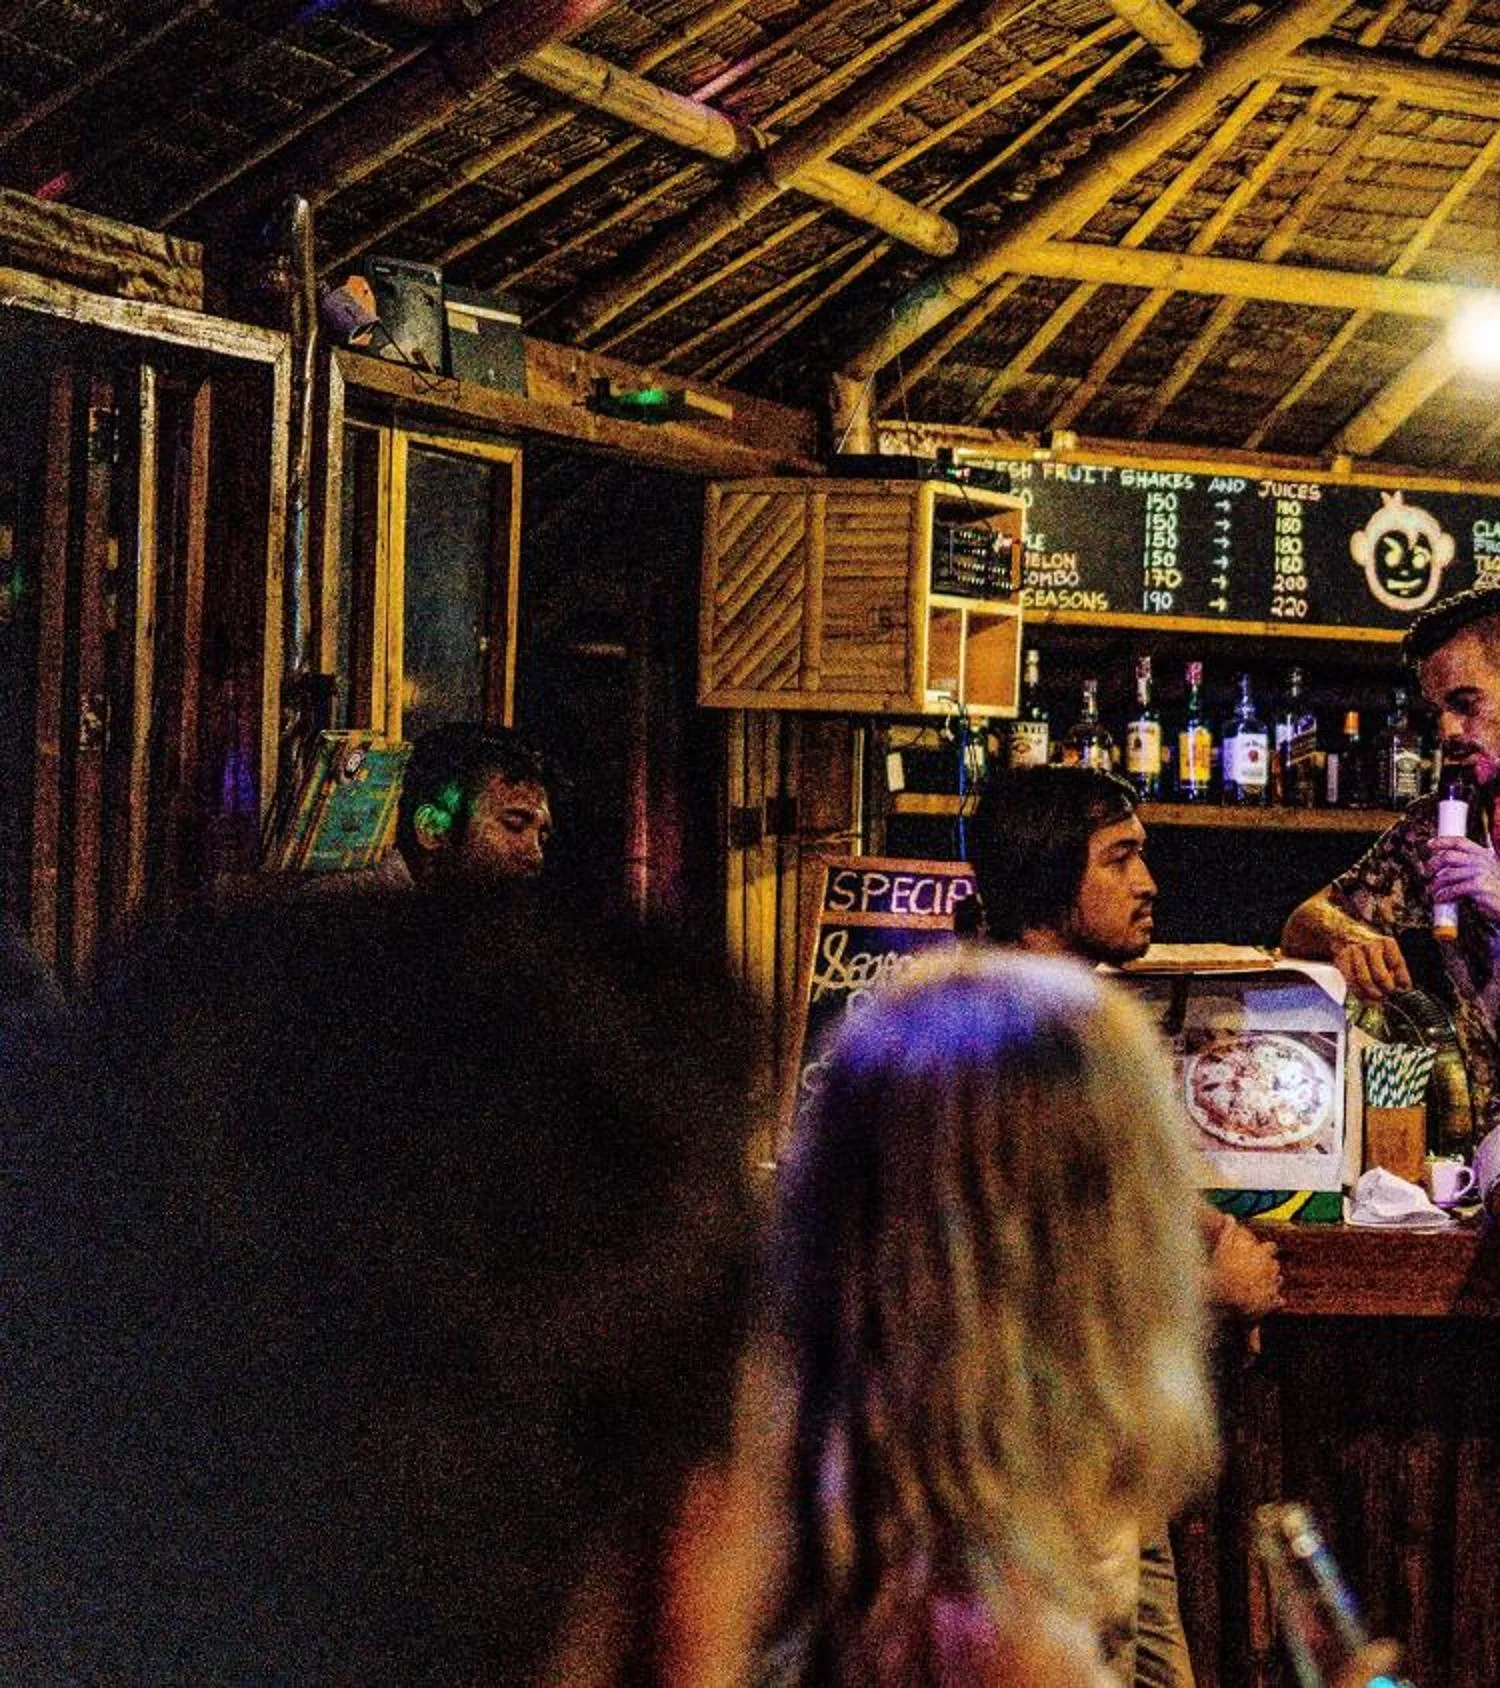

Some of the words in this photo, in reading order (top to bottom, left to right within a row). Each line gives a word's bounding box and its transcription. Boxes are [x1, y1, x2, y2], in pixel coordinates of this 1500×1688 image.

[1042, 462, 1113, 483] FRUIT
[1120, 470, 1195, 490] SHAKES
[1208, 477, 1246, 494] AND
[1258, 481, 1321, 500] JUICES
[1147, 493, 1178, 512] 150
[1146, 514, 1178, 532] 150
[1145, 532, 1178, 550] 150
[1275, 536, 1303, 555] 180
[1144, 552, 1177, 569] 150
[1272, 575, 1308, 592] 200
[1021, 588, 1109, 611] SEASONS
[1143, 591, 1174, 612] 190
[1270, 597, 1308, 617] 220
